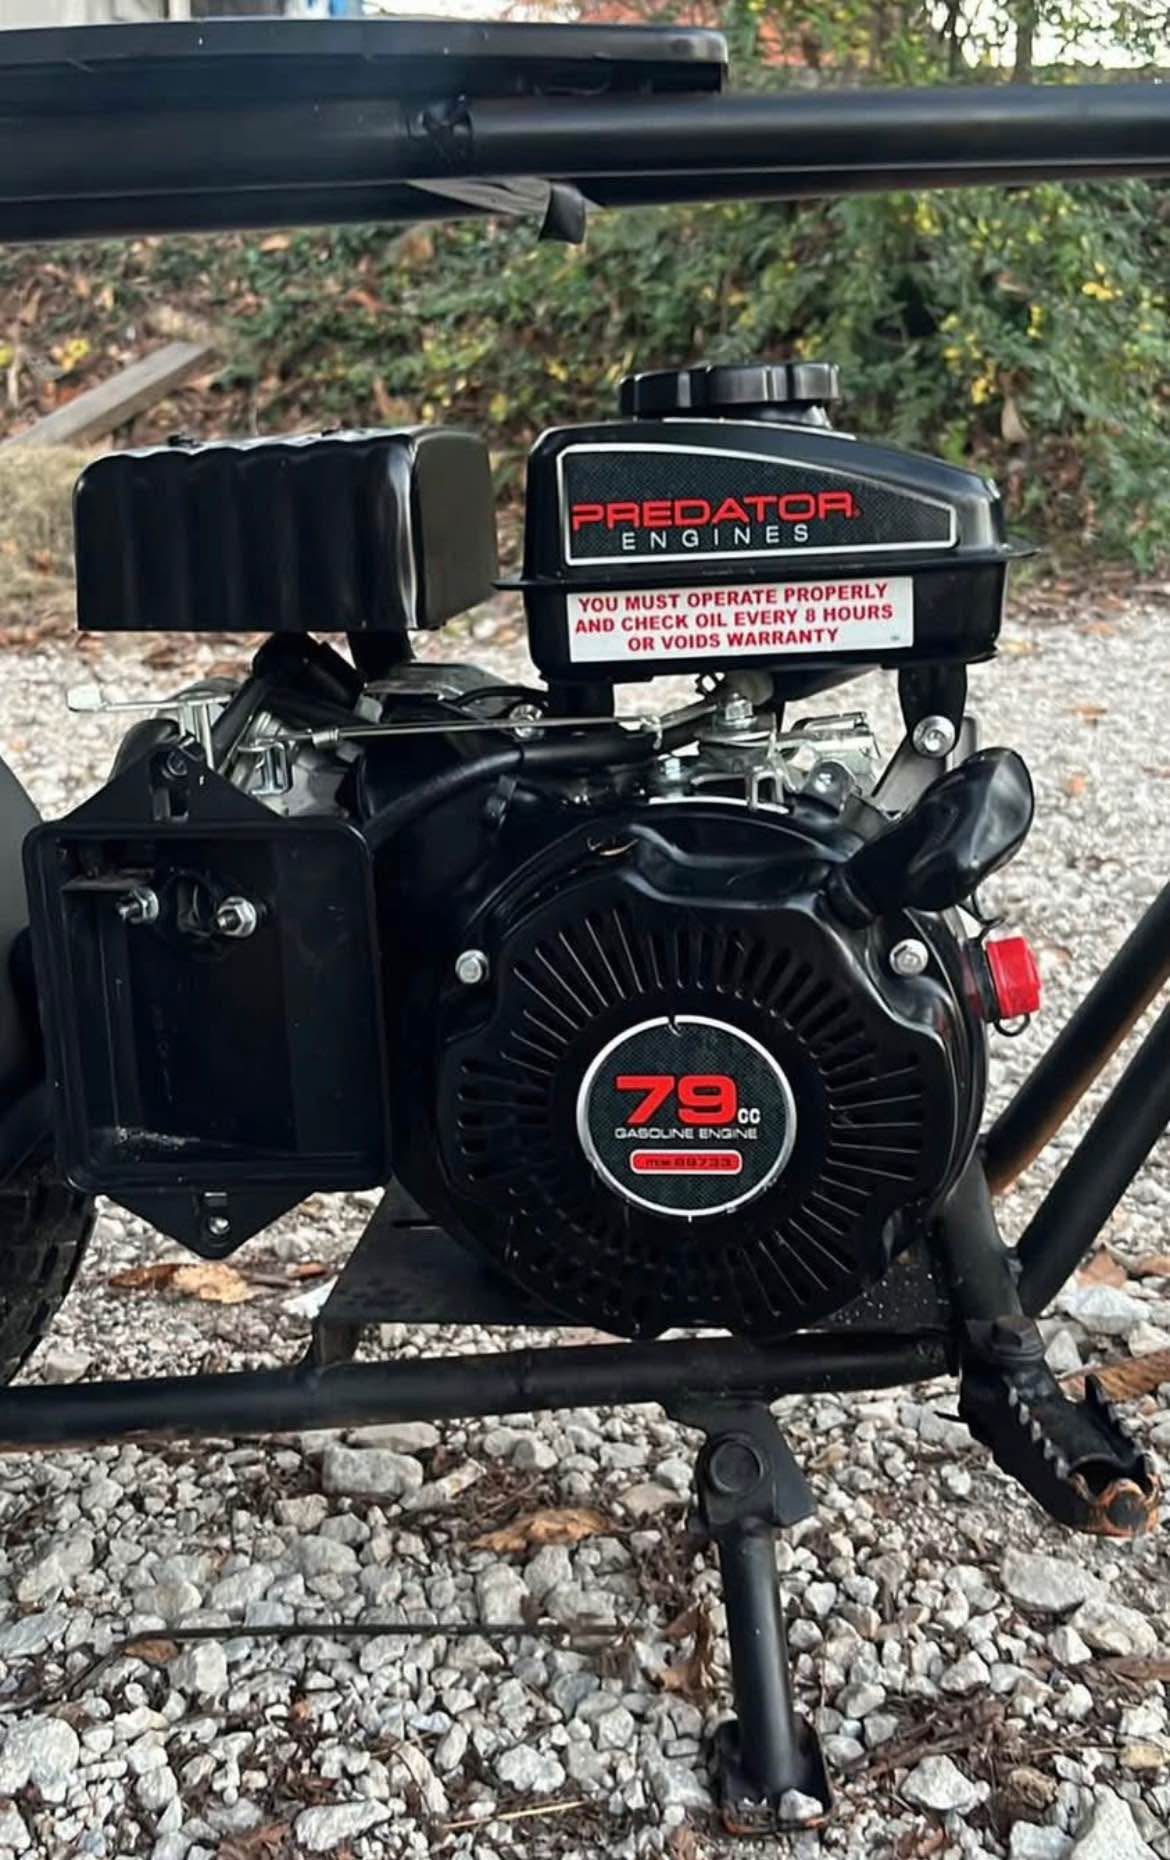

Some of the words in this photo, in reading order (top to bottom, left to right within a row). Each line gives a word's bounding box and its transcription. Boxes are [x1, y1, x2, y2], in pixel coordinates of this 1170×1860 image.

[621, 523, 809, 551] ENGINES
[578, 597, 618, 612] YOU
[625, 594, 680, 611] MUST
[687, 589, 777, 608] OPERATE
[784, 583, 888, 603] PROPERLY
[575, 618, 615, 634] AND
[621, 614, 689, 631] CHECK
[695, 612, 727, 628] OIL
[734, 609, 798, 626] EVERY
[805, 608, 816, 623] 8
[823, 604, 893, 622] HOURS
[627, 637, 655, 652] OR
[661, 633, 721, 650] VOIDS
[726, 627, 839, 647] WARRANTY
[616, 1074, 738, 1124] 79
[615, 1128, 694, 1139] GASOLINE
[699, 1128, 758, 1139] ENGINE
